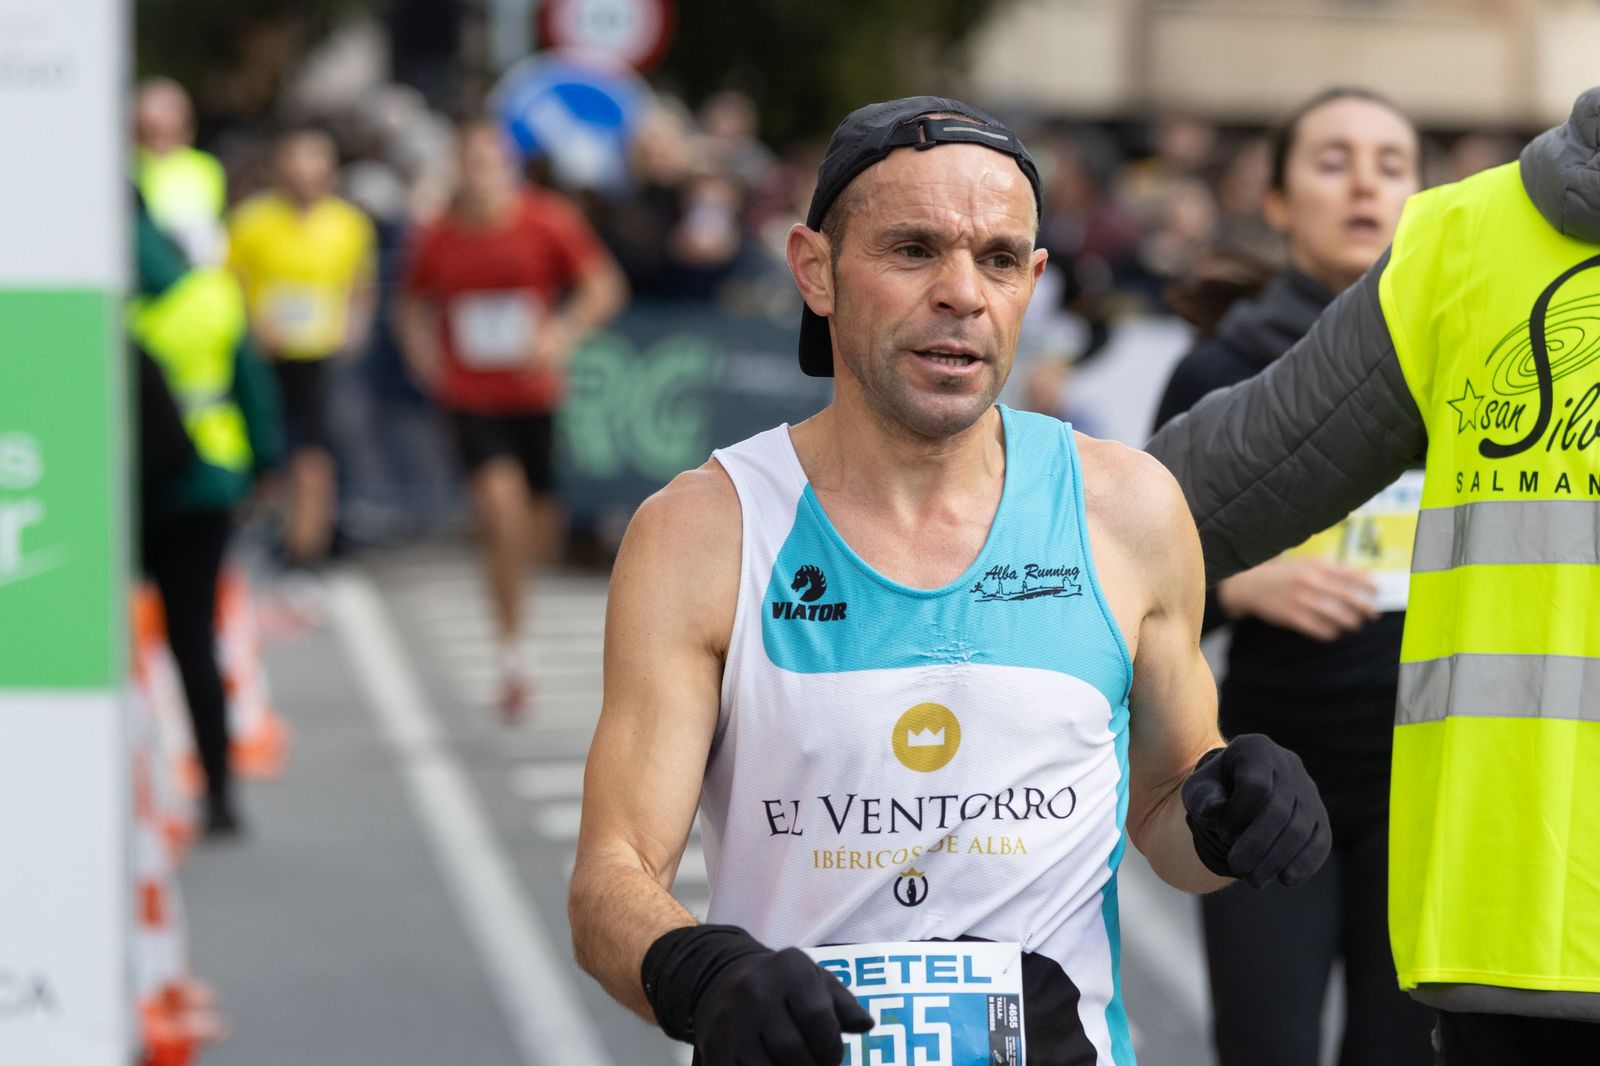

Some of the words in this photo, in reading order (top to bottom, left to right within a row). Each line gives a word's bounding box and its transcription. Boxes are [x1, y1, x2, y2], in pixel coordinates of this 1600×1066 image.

[1480, 400, 1526, 433] san
[984, 564, 1018, 582] Alba
[1024, 563, 1081, 581] Running
[771, 601, 847, 623] VIATOR
[761, 799, 803, 837] EL
[817, 786, 1077, 835] VENTORRO
[811, 845, 924, 870] IBÉRICOS
[967, 835, 1029, 856] ALBA
